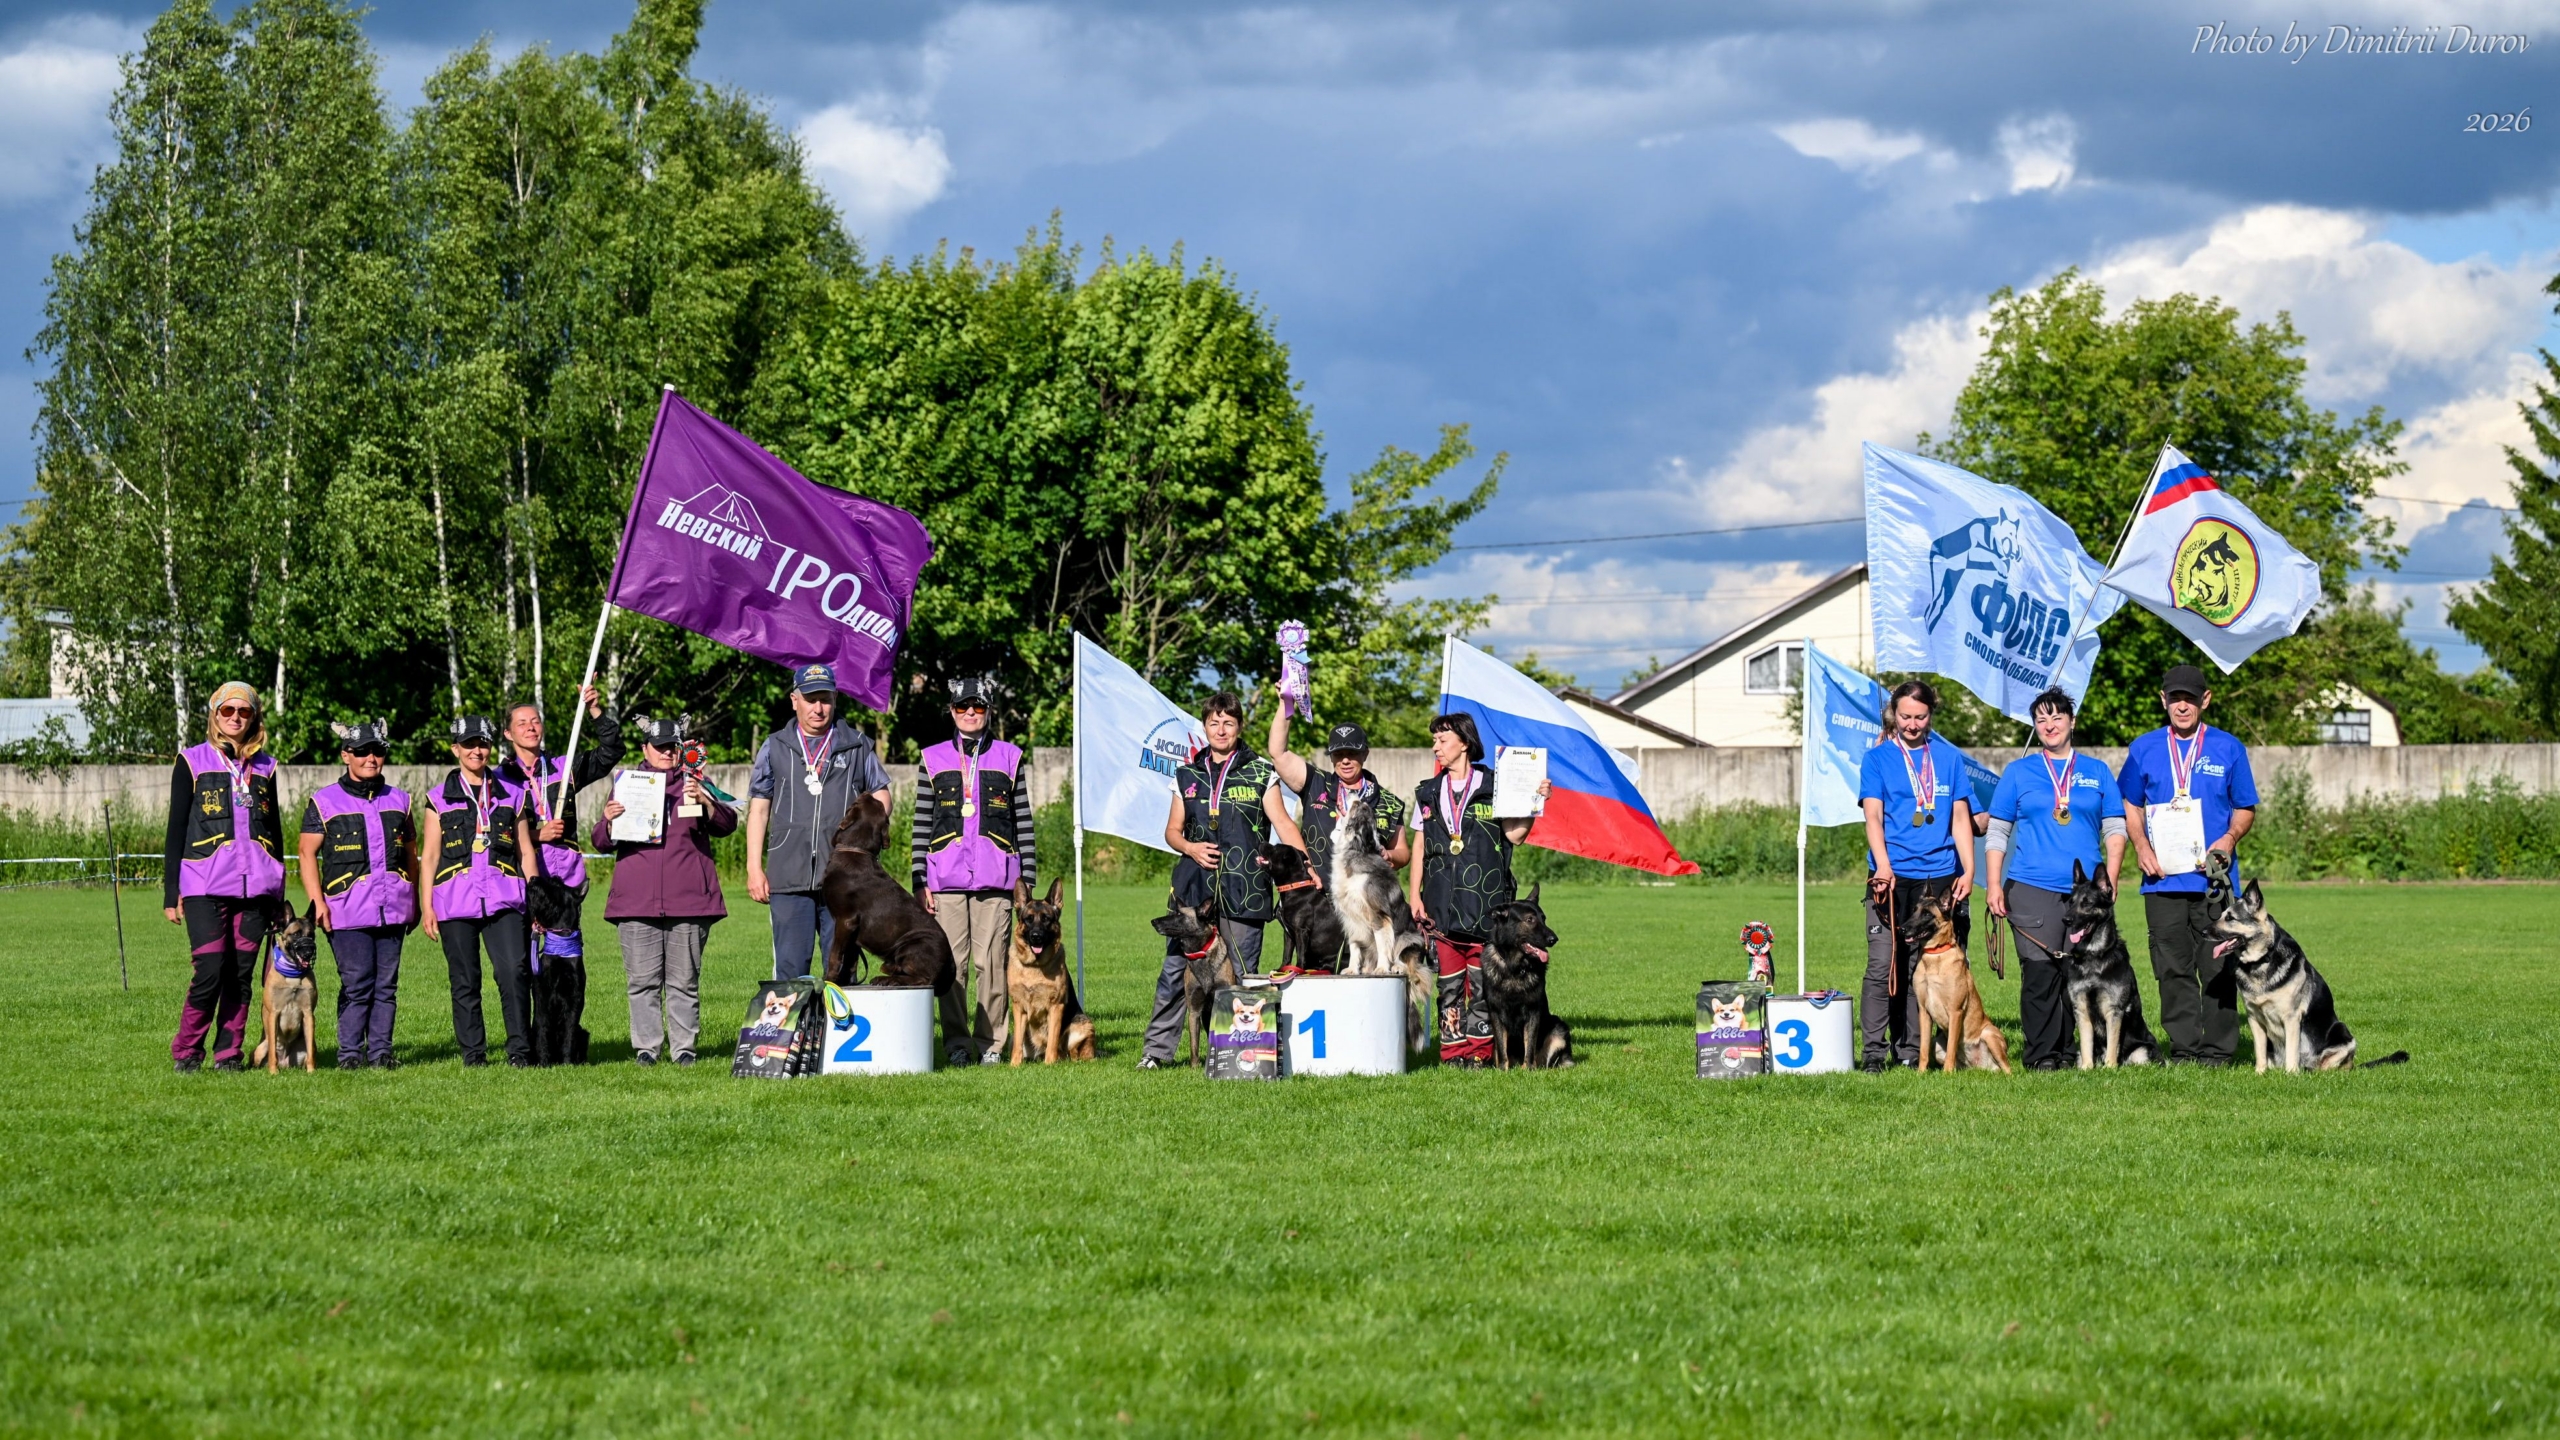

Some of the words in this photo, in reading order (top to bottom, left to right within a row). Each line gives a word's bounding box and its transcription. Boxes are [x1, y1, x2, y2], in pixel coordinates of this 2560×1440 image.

[656, 501, 763, 562] Невский
[1970, 579, 2071, 667] ФСПС
[2202, 763, 2225, 774] ФСПС
[334, 843, 362, 852] Светлана
[832, 1014, 873, 1063] 2
[1298, 1009, 1327, 1059] 1
[1774, 1019, 1814, 1069] 3
